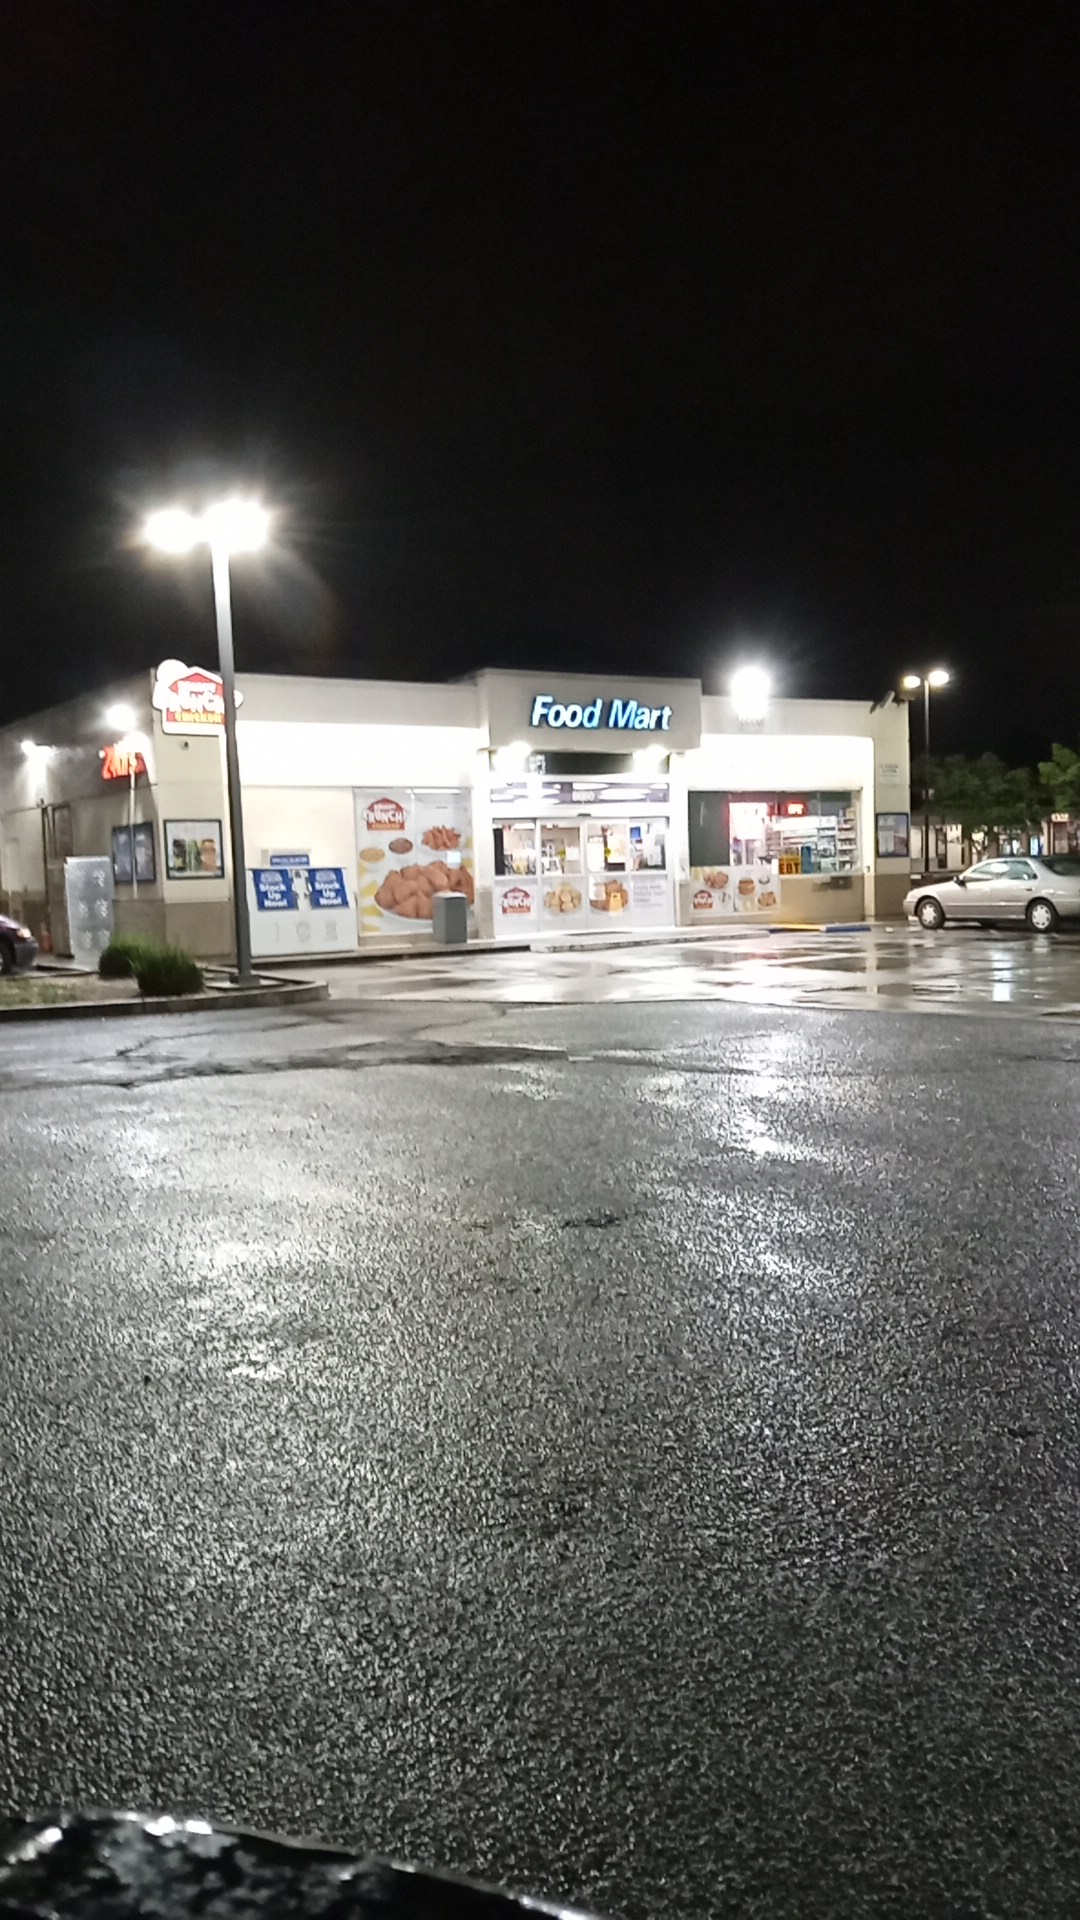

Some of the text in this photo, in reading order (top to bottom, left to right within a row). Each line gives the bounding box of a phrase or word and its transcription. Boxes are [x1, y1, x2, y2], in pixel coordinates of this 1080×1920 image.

[531, 695, 673, 730] Food Mart
[779, 862, 799, 874] EBT
[267, 890, 281, 900] Up
[322, 888, 336, 899] Up
